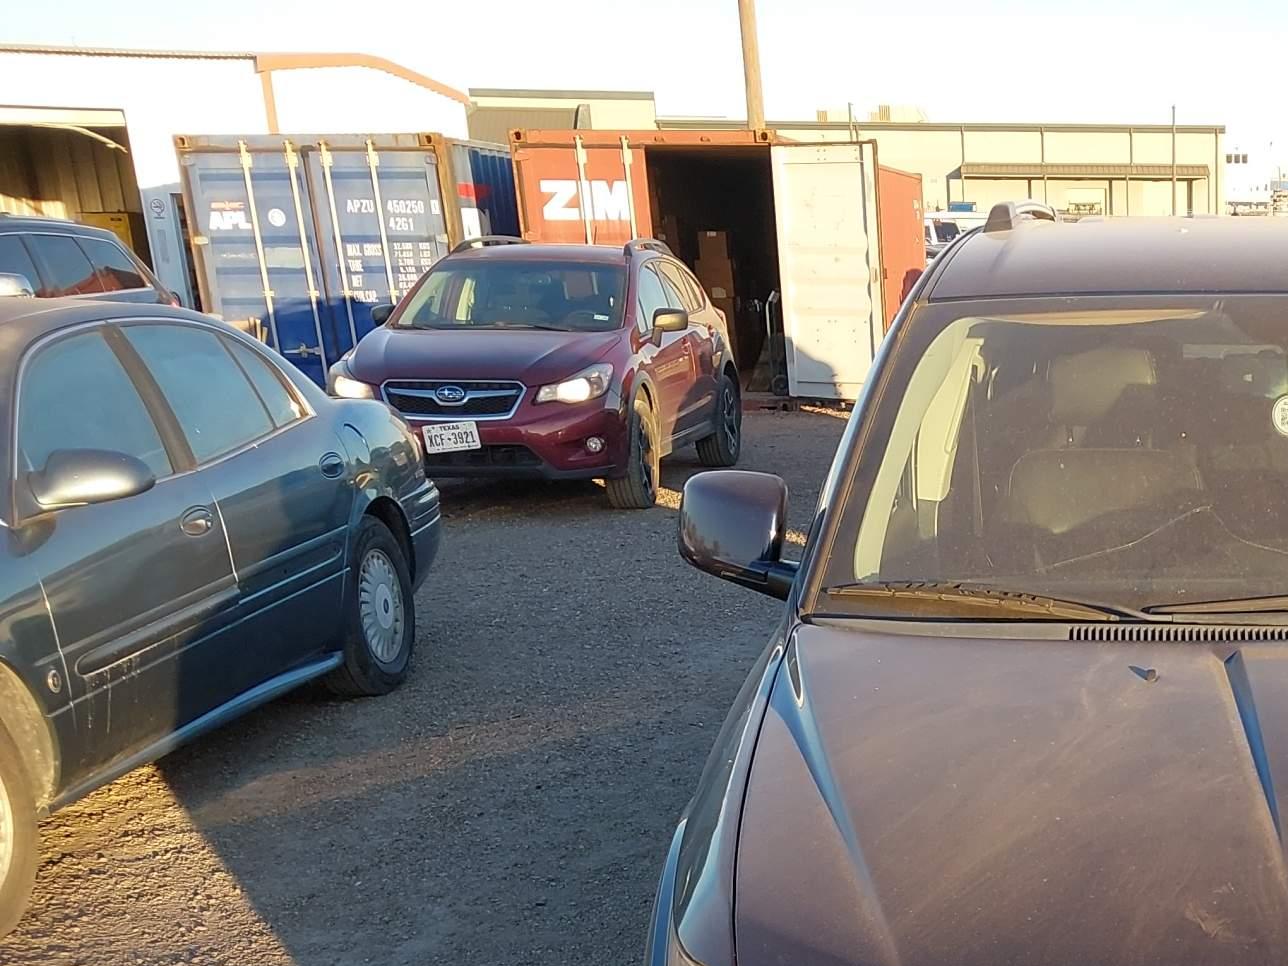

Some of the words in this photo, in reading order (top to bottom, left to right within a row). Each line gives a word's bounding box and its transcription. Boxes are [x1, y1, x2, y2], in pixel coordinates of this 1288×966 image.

[346, 199, 375, 213] APZU
[386, 199, 425, 213] 450250
[540, 179, 631, 221] ZIM
[209, 210, 252, 230] APL
[389, 217, 415, 231] 42G1
[439, 424, 460, 432] TEXAS
